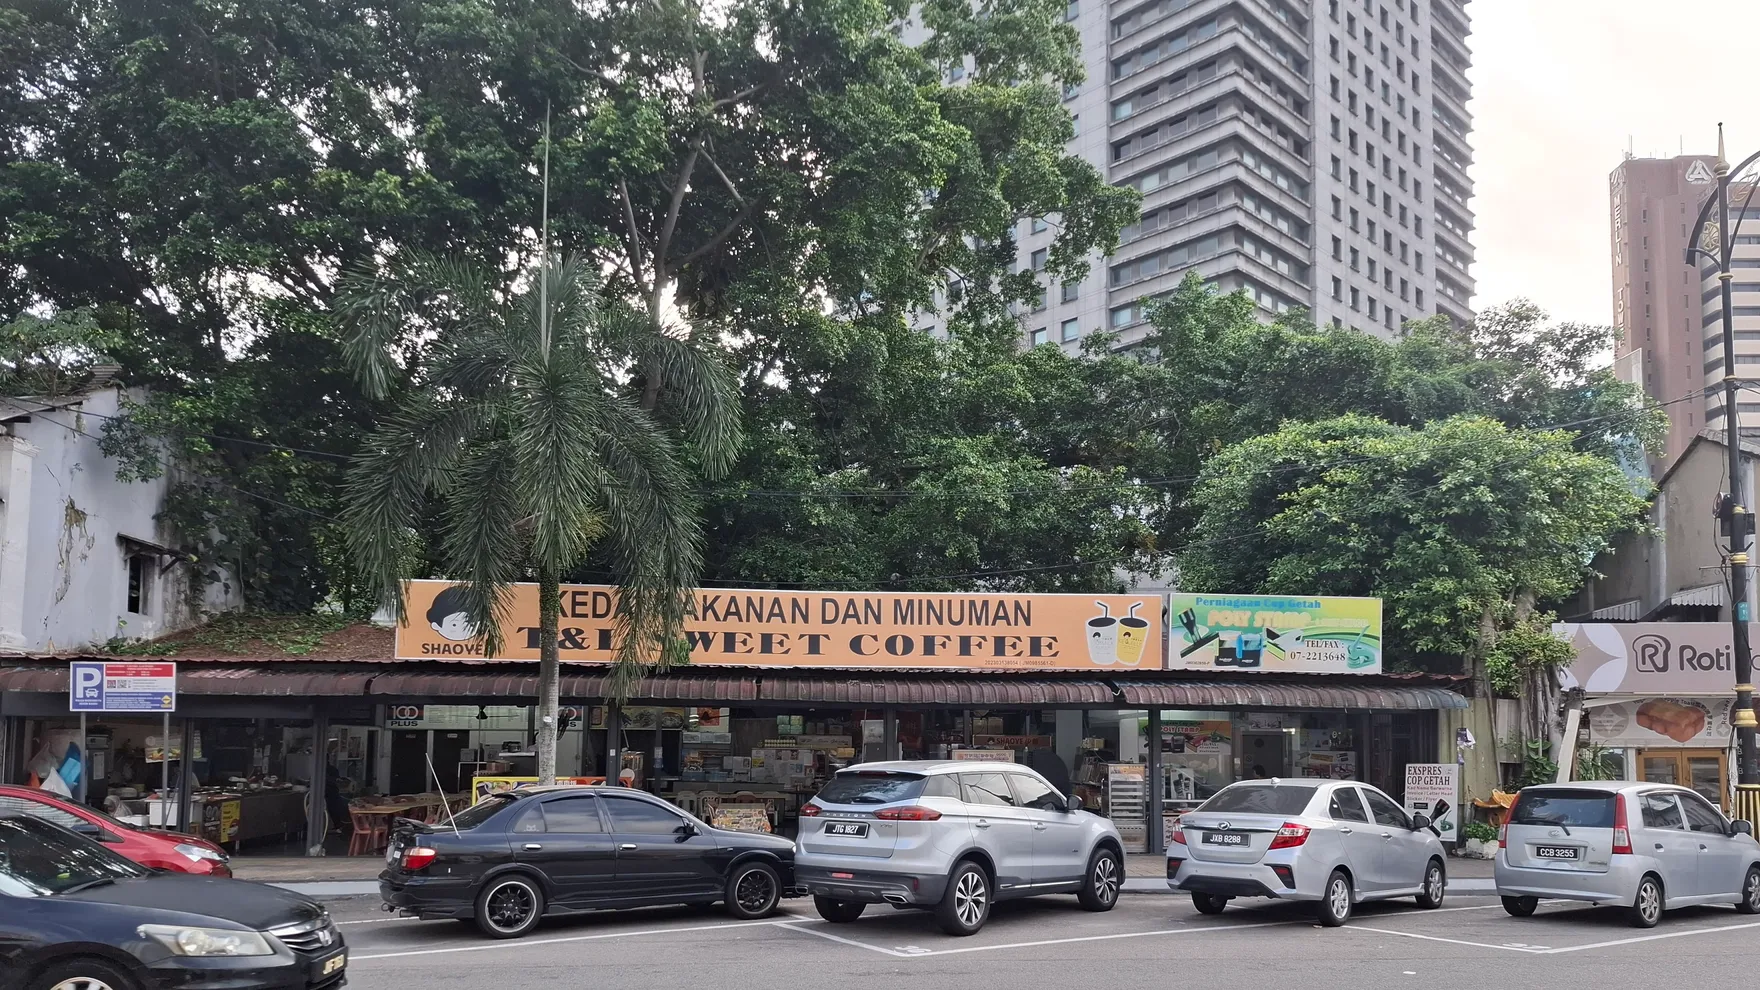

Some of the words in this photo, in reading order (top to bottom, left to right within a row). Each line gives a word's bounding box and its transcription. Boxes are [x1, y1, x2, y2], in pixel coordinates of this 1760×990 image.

[1614, 194, 1622, 267] MERLIN
[1196, 597, 1260, 608] Perniagaan
[1288, 599, 1321, 608] Getah
[655, 594, 809, 624] AKANAN
[821, 597, 882, 625] DAN
[893, 598, 1031, 627] MINUMAN
[1207, 610, 1251, 627] POLY
[1253, 611, 1312, 628] STAMP
[421, 642, 483, 655] SHAOYE
[655, 631, 831, 656] WEET
[848, 633, 1060, 658] COFFEE
[1305, 640, 1339, 649] TEL/FAX
[1290, 651, 1346, 661] 07-2213648
[1678, 644, 1731, 671] Roti
[75, 667, 102, 699] P
[392, 705, 419, 720] 100
[996, 737, 1024, 745] SHAOYE
[1407, 766, 1442, 776] EXSPRES
[1406, 776, 1423, 786] COP
[1423, 776, 1450, 786] GETAH
[832, 825, 845, 834] JTG
[845, 825, 859, 834] 1827
[1210, 834, 1223, 842] JXB
[1224, 834, 1241, 843] 8288
[1540, 848, 1554, 857] CCB
[1556, 849, 1575, 857] 3255
